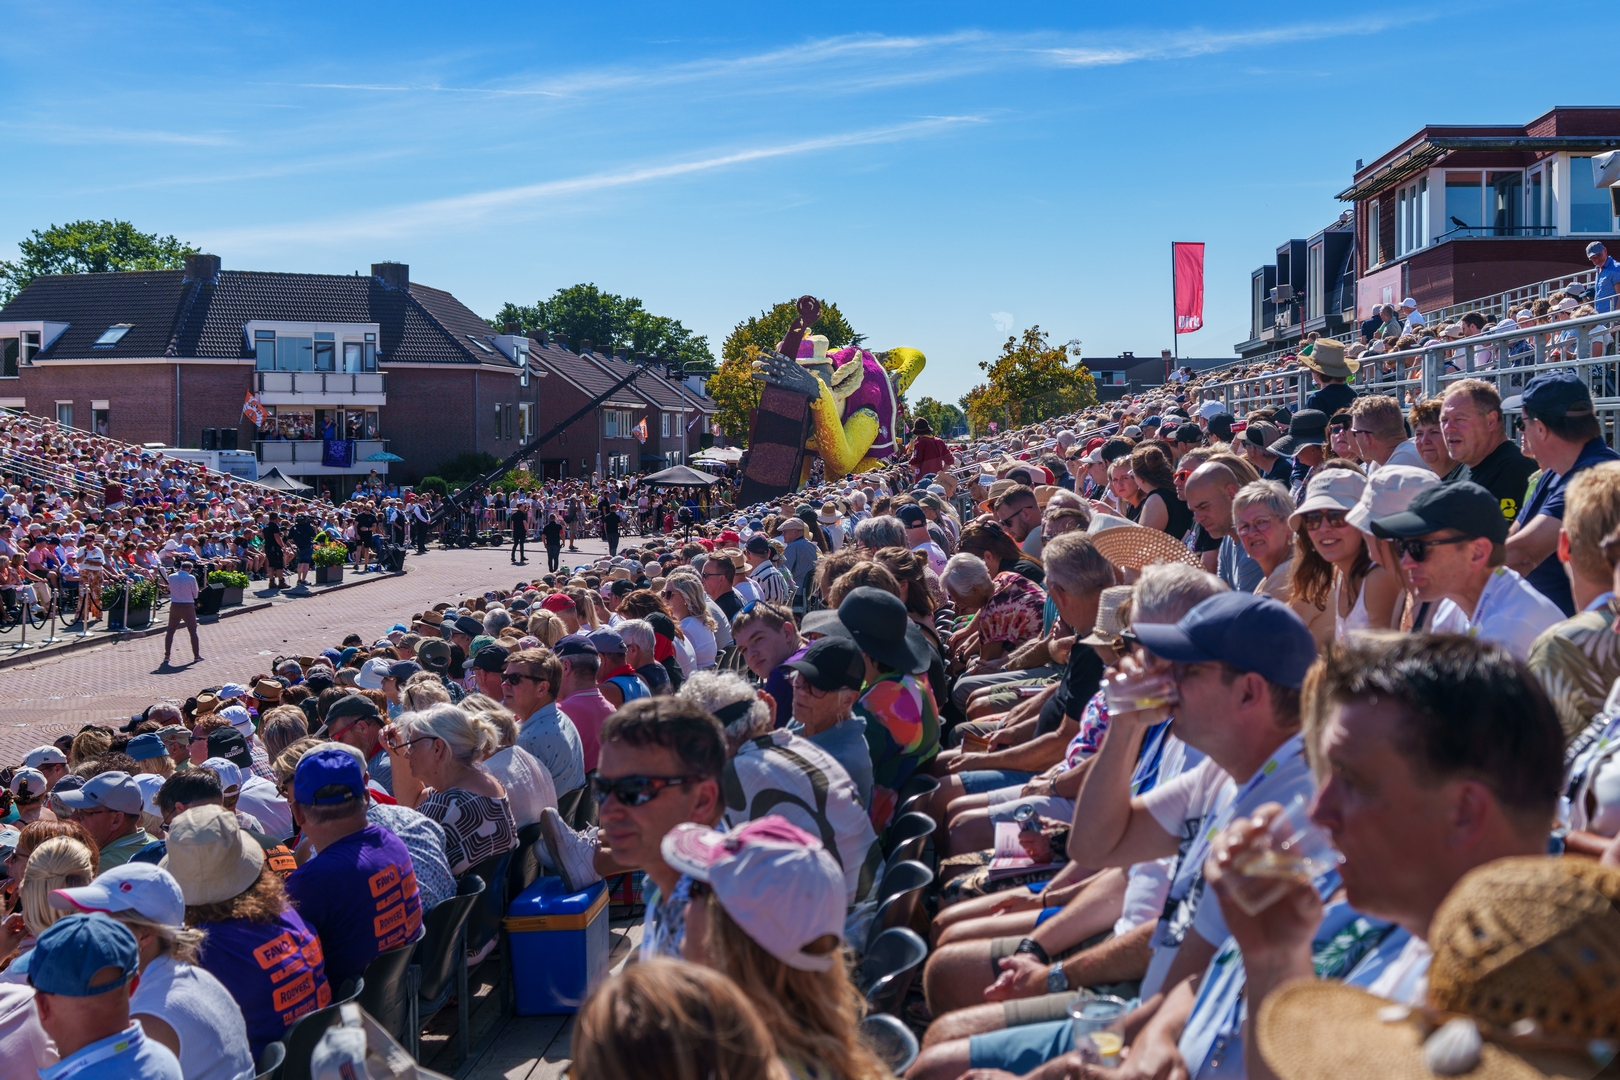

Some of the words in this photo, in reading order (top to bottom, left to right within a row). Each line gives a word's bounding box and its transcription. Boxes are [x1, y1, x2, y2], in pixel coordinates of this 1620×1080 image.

[1178, 315, 1200, 329] Dirk
[375, 871, 395, 890] FAVO
[380, 908, 403, 930] ROOVERS
[262, 941, 290, 961] FAVO
[280, 977, 311, 1005] ROOVERS
